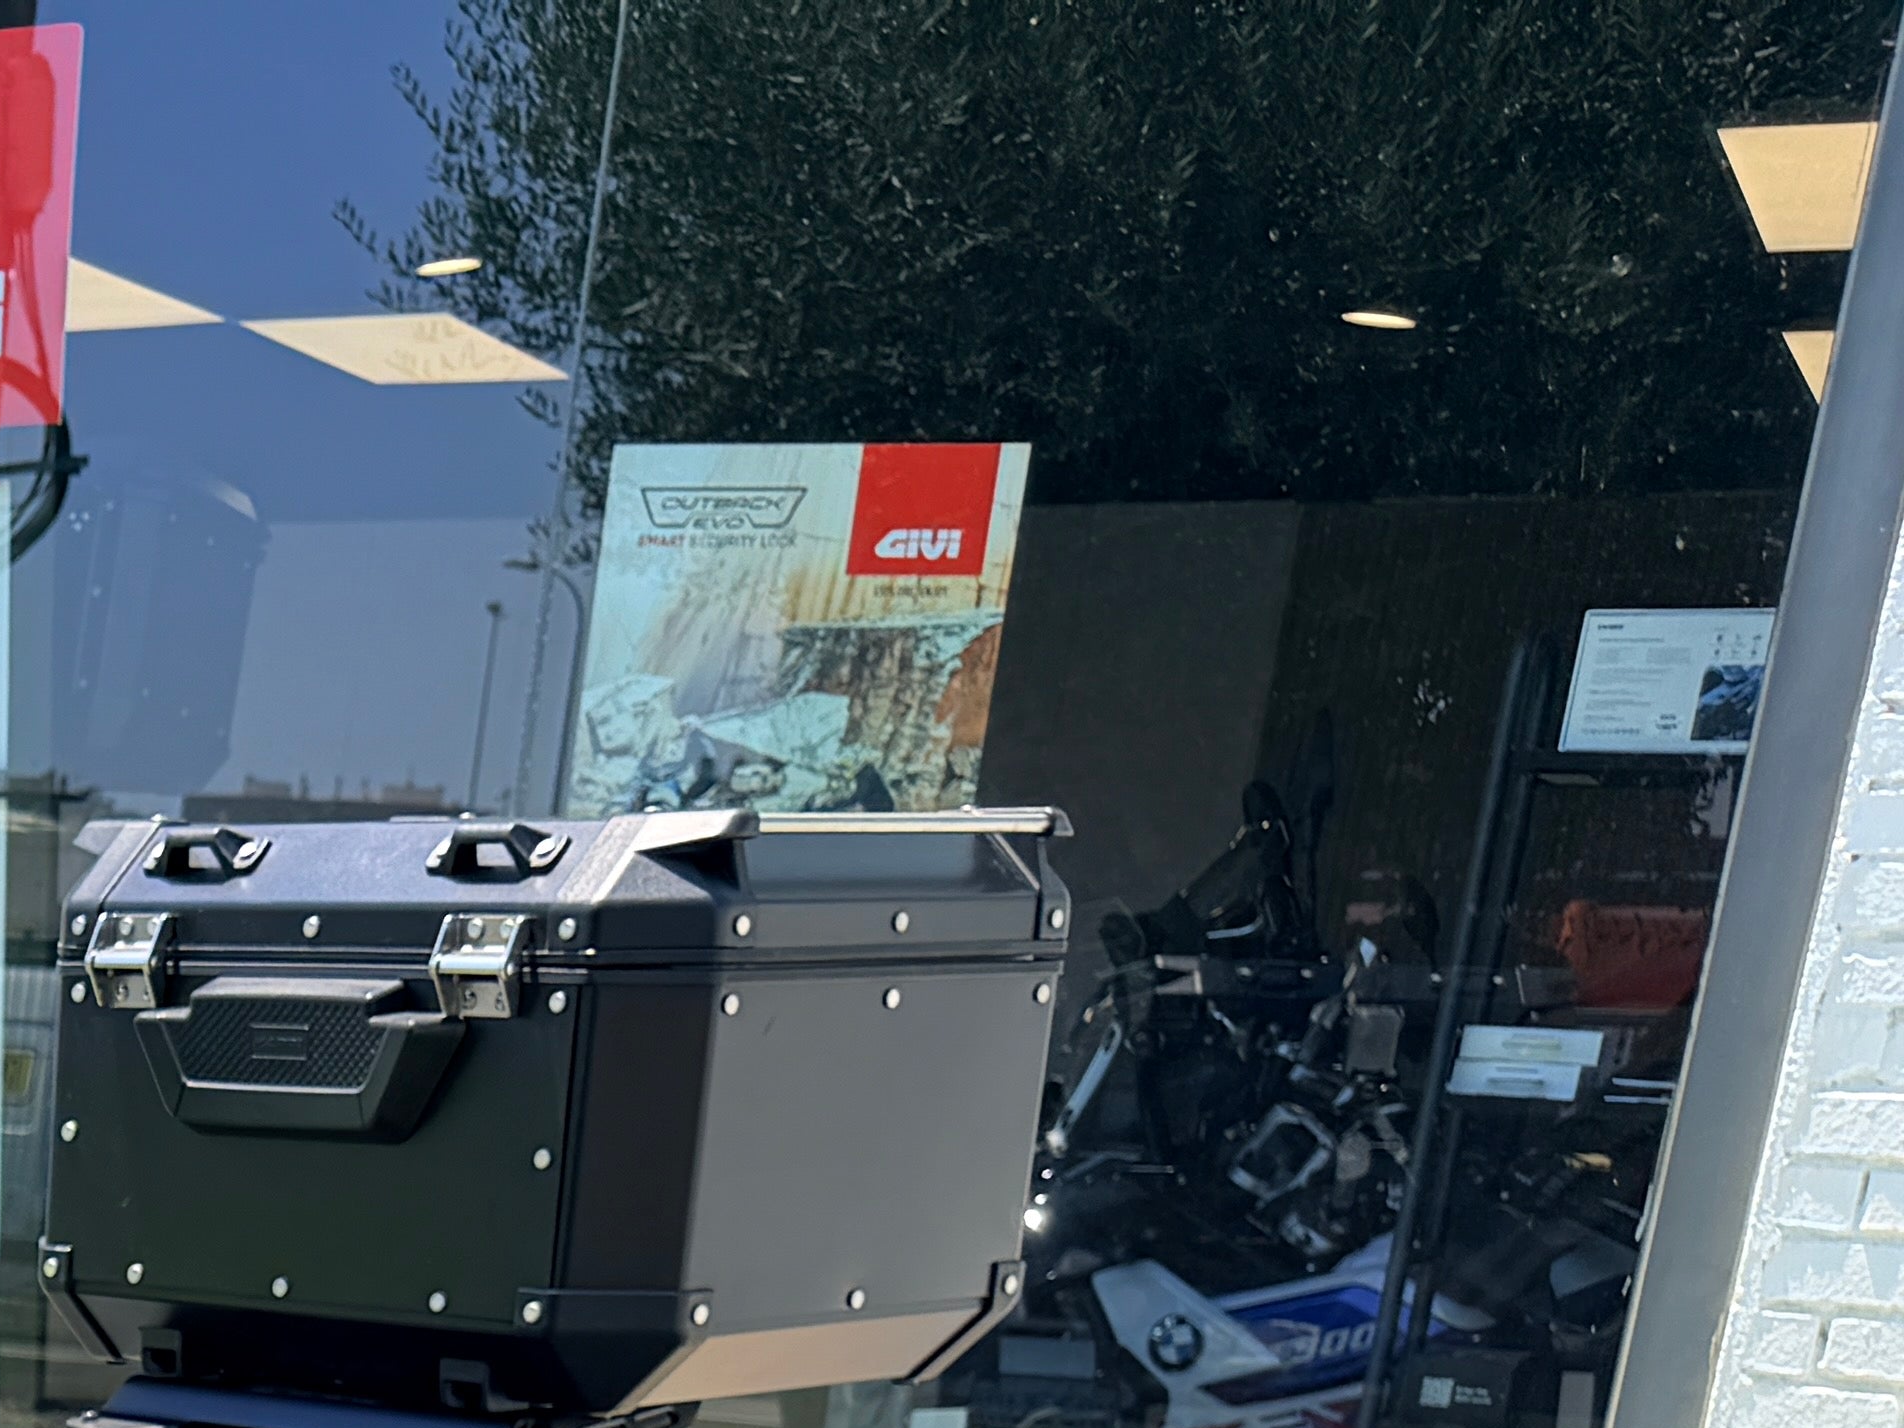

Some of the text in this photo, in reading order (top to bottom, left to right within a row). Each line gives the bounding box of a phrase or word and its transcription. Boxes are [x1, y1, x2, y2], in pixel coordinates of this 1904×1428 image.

[661, 496, 787, 511] OUTBACK
[693, 517, 745, 530] EVO
[874, 528, 963, 561] GIVI
